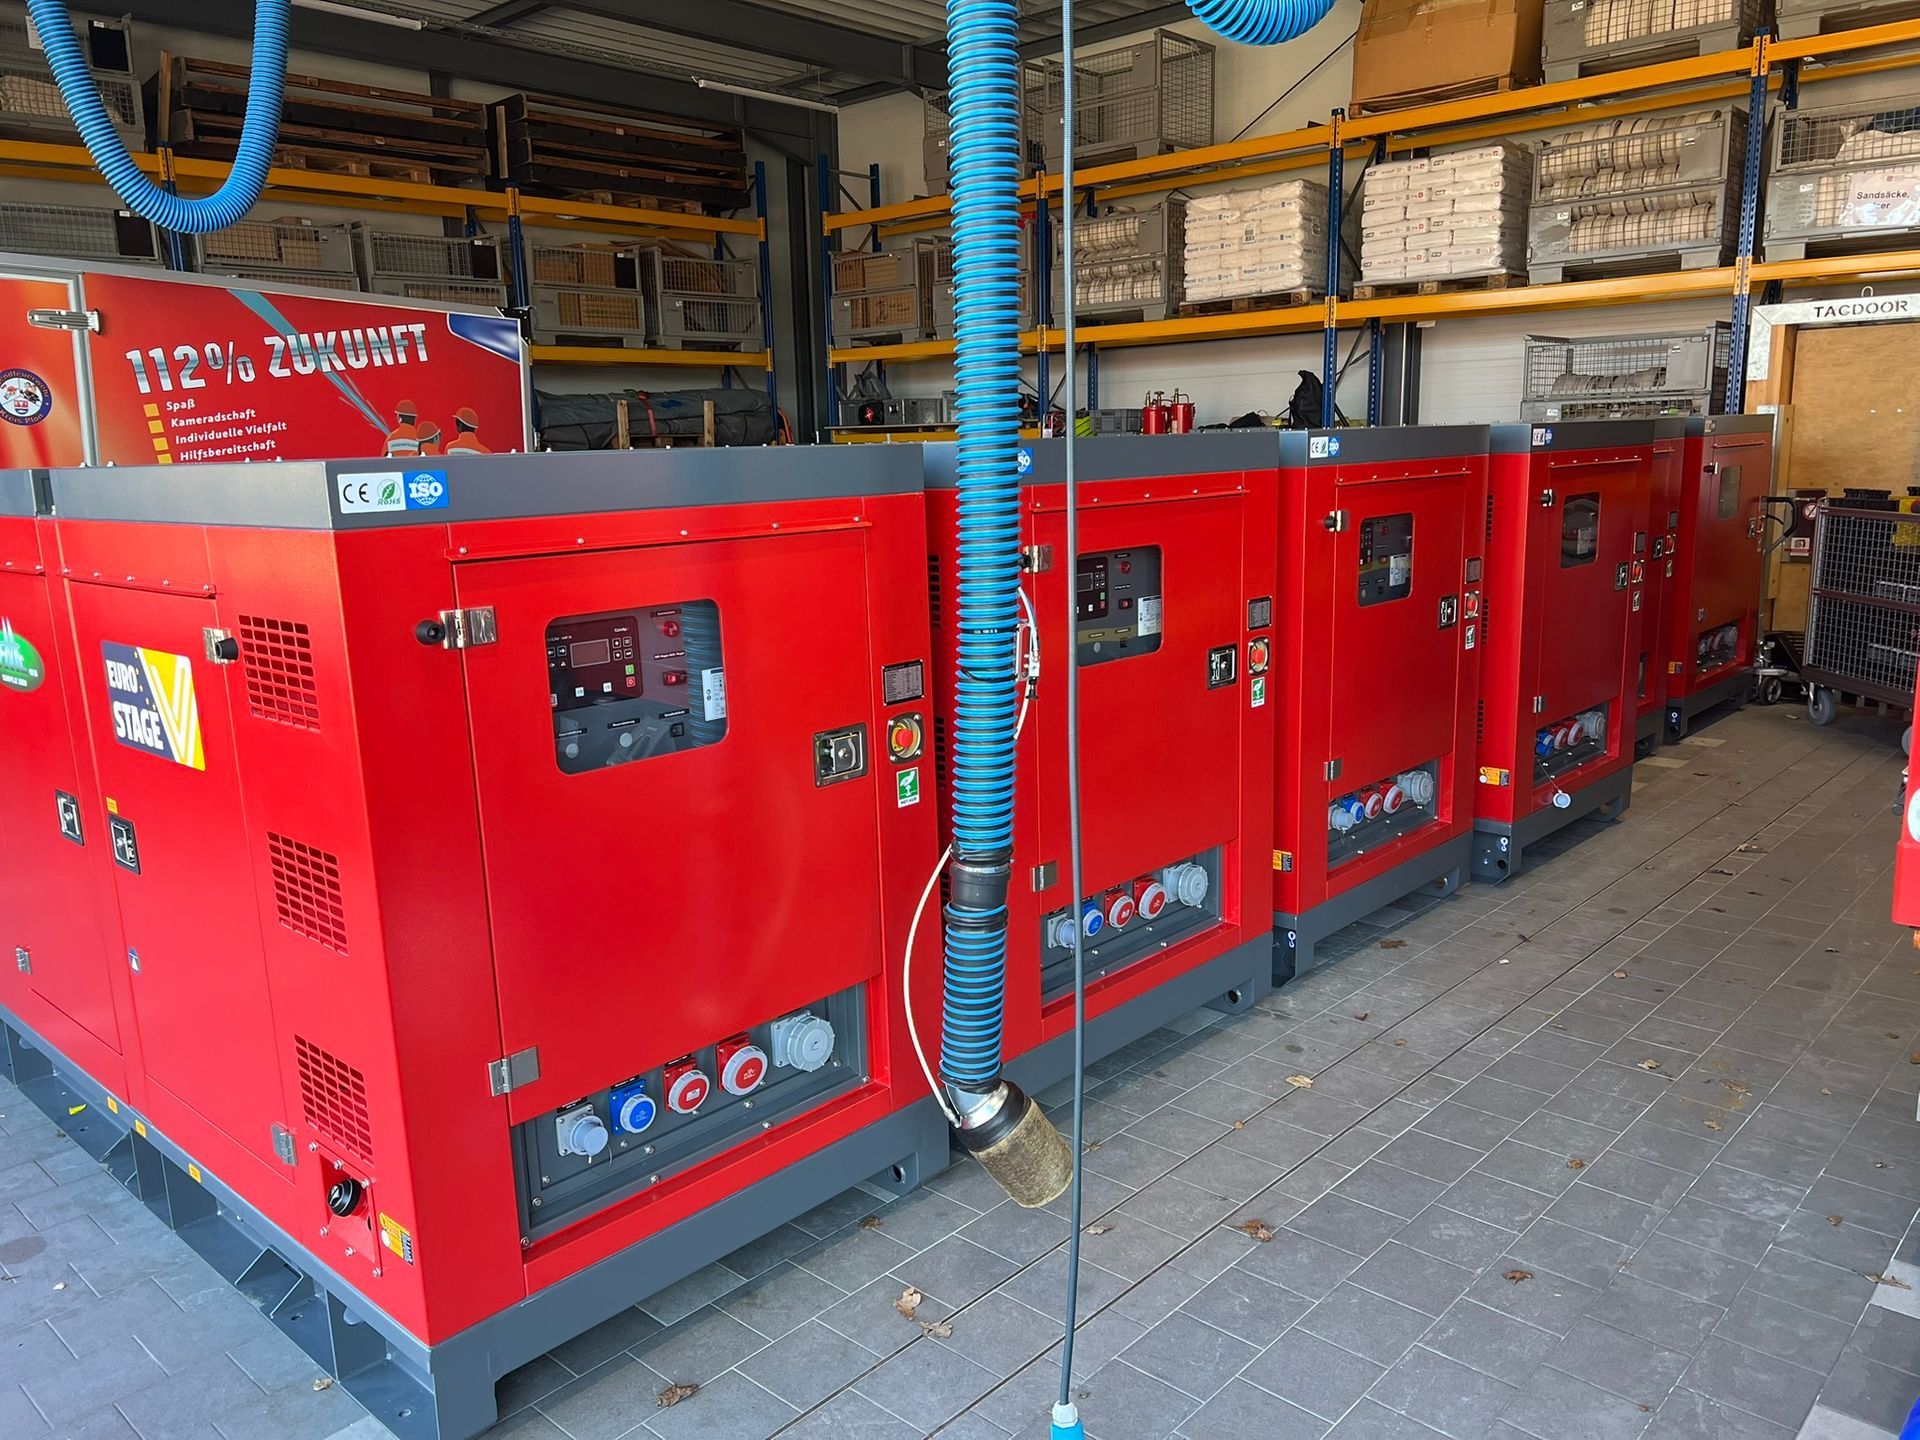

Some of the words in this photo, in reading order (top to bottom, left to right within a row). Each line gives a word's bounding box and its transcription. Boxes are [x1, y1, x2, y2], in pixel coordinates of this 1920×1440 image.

[1813, 300, 1909, 318] TACDOOR
[126, 341, 256, 394] 112%
[263, 323, 428, 378] ZUKUNFT
[166, 398, 196, 412] Spaß
[171, 408, 256, 428] Kameradschaft
[175, 427, 243, 445] Individuelle
[245, 421, 288, 435] Vielfalt
[180, 439, 277, 461] Hilfsbereitschaft
[343, 482, 370, 504] CE
[408, 481, 443, 499] ISO
[105, 659, 139, 694] EURO
[113, 700, 164, 751] STAGE
